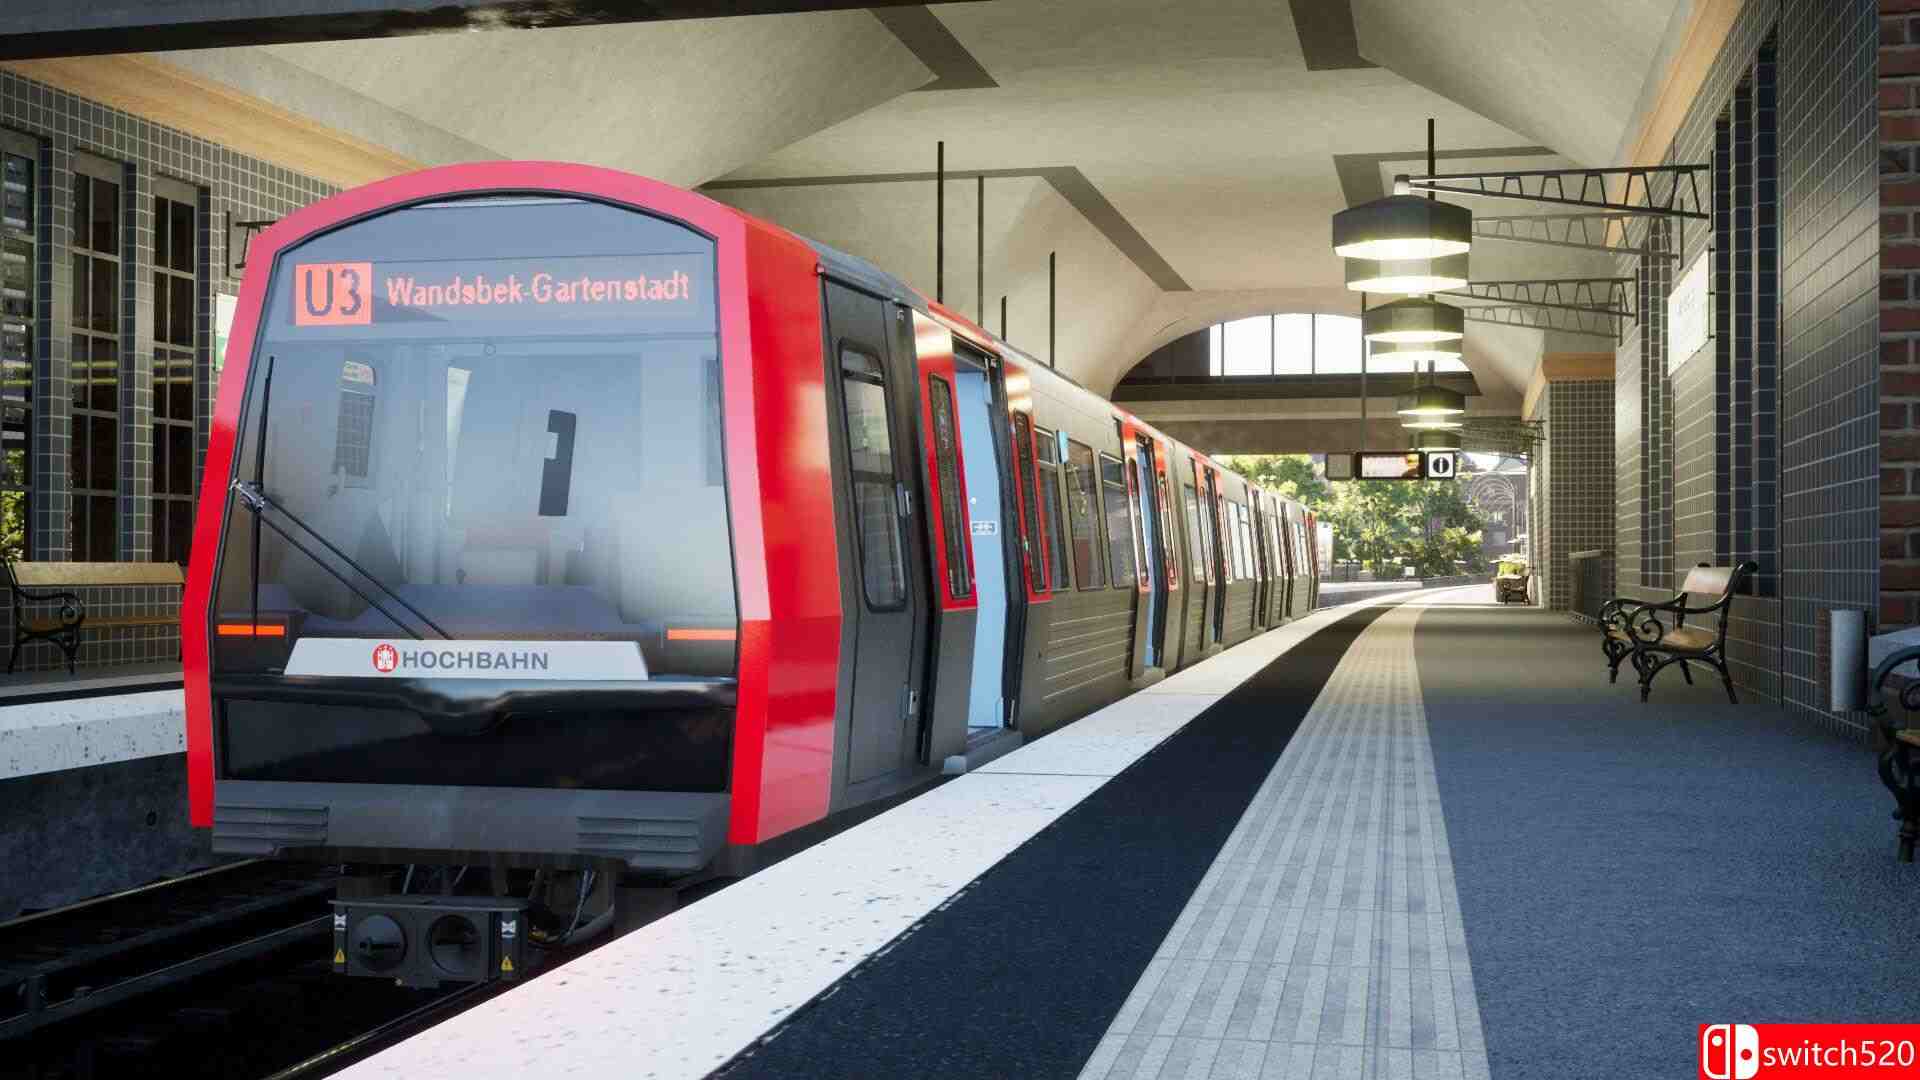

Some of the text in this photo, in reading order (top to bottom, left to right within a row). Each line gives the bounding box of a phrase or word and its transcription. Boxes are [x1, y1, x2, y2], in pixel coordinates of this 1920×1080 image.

[304, 268, 690, 317] U3 Wandsbek-Gartenstadt
[402, 650, 549, 670] HOCHBAHN
